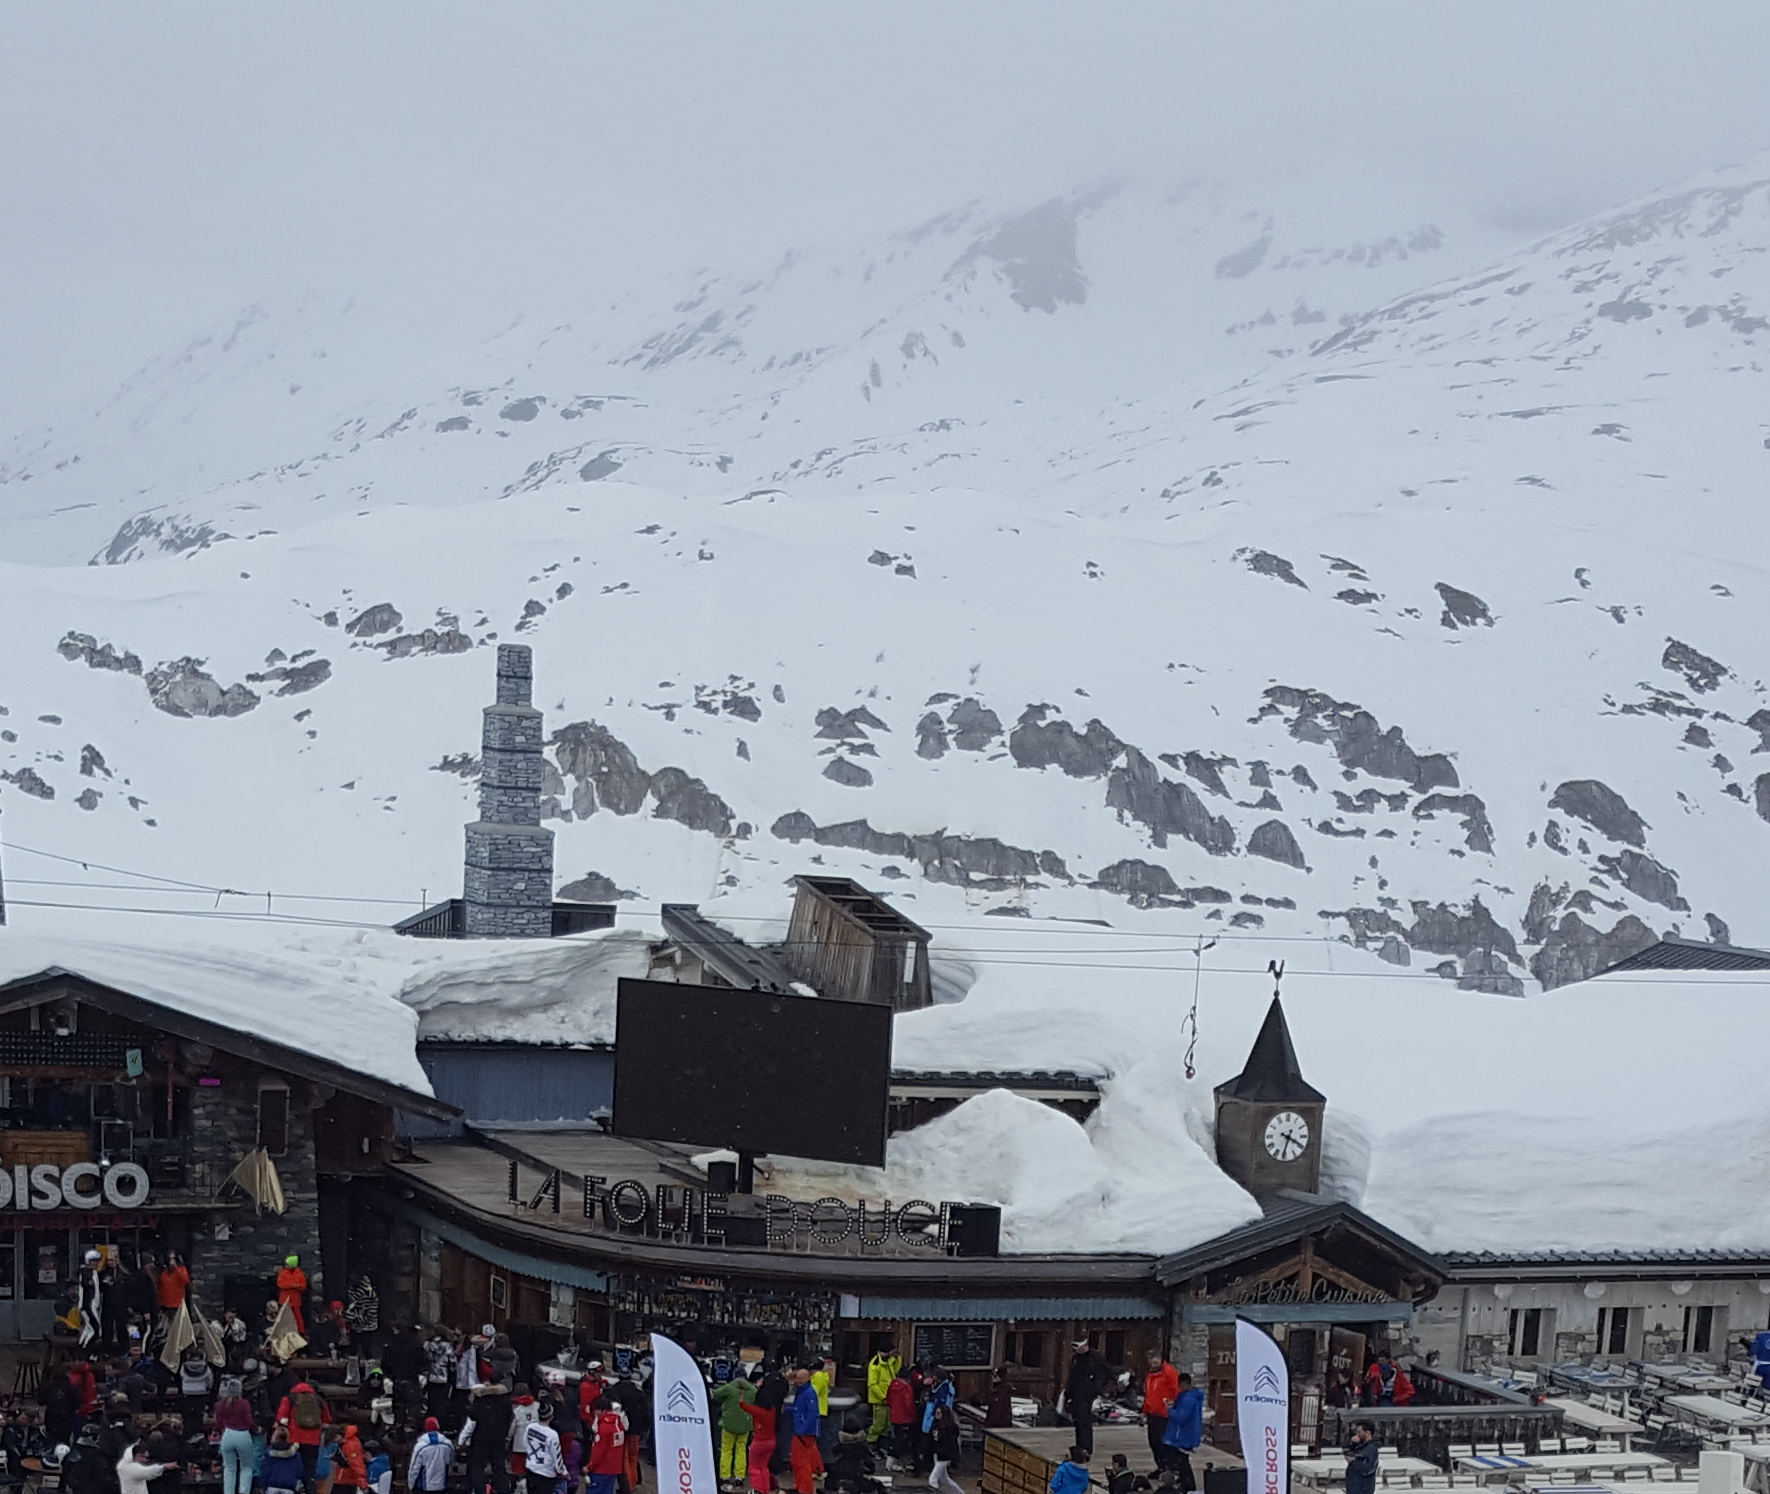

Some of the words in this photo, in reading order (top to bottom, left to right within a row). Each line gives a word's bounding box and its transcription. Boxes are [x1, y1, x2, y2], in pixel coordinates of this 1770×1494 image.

[508, 1161, 561, 1214] LA
[584, 1174, 728, 1235] FOLIE
[766, 1194, 964, 1247] DOUCE
[1221, 1276, 1254, 1308] La
[1254, 1278, 1311, 1305] Petite
[1312, 1278, 1389, 1304] Cuisine
